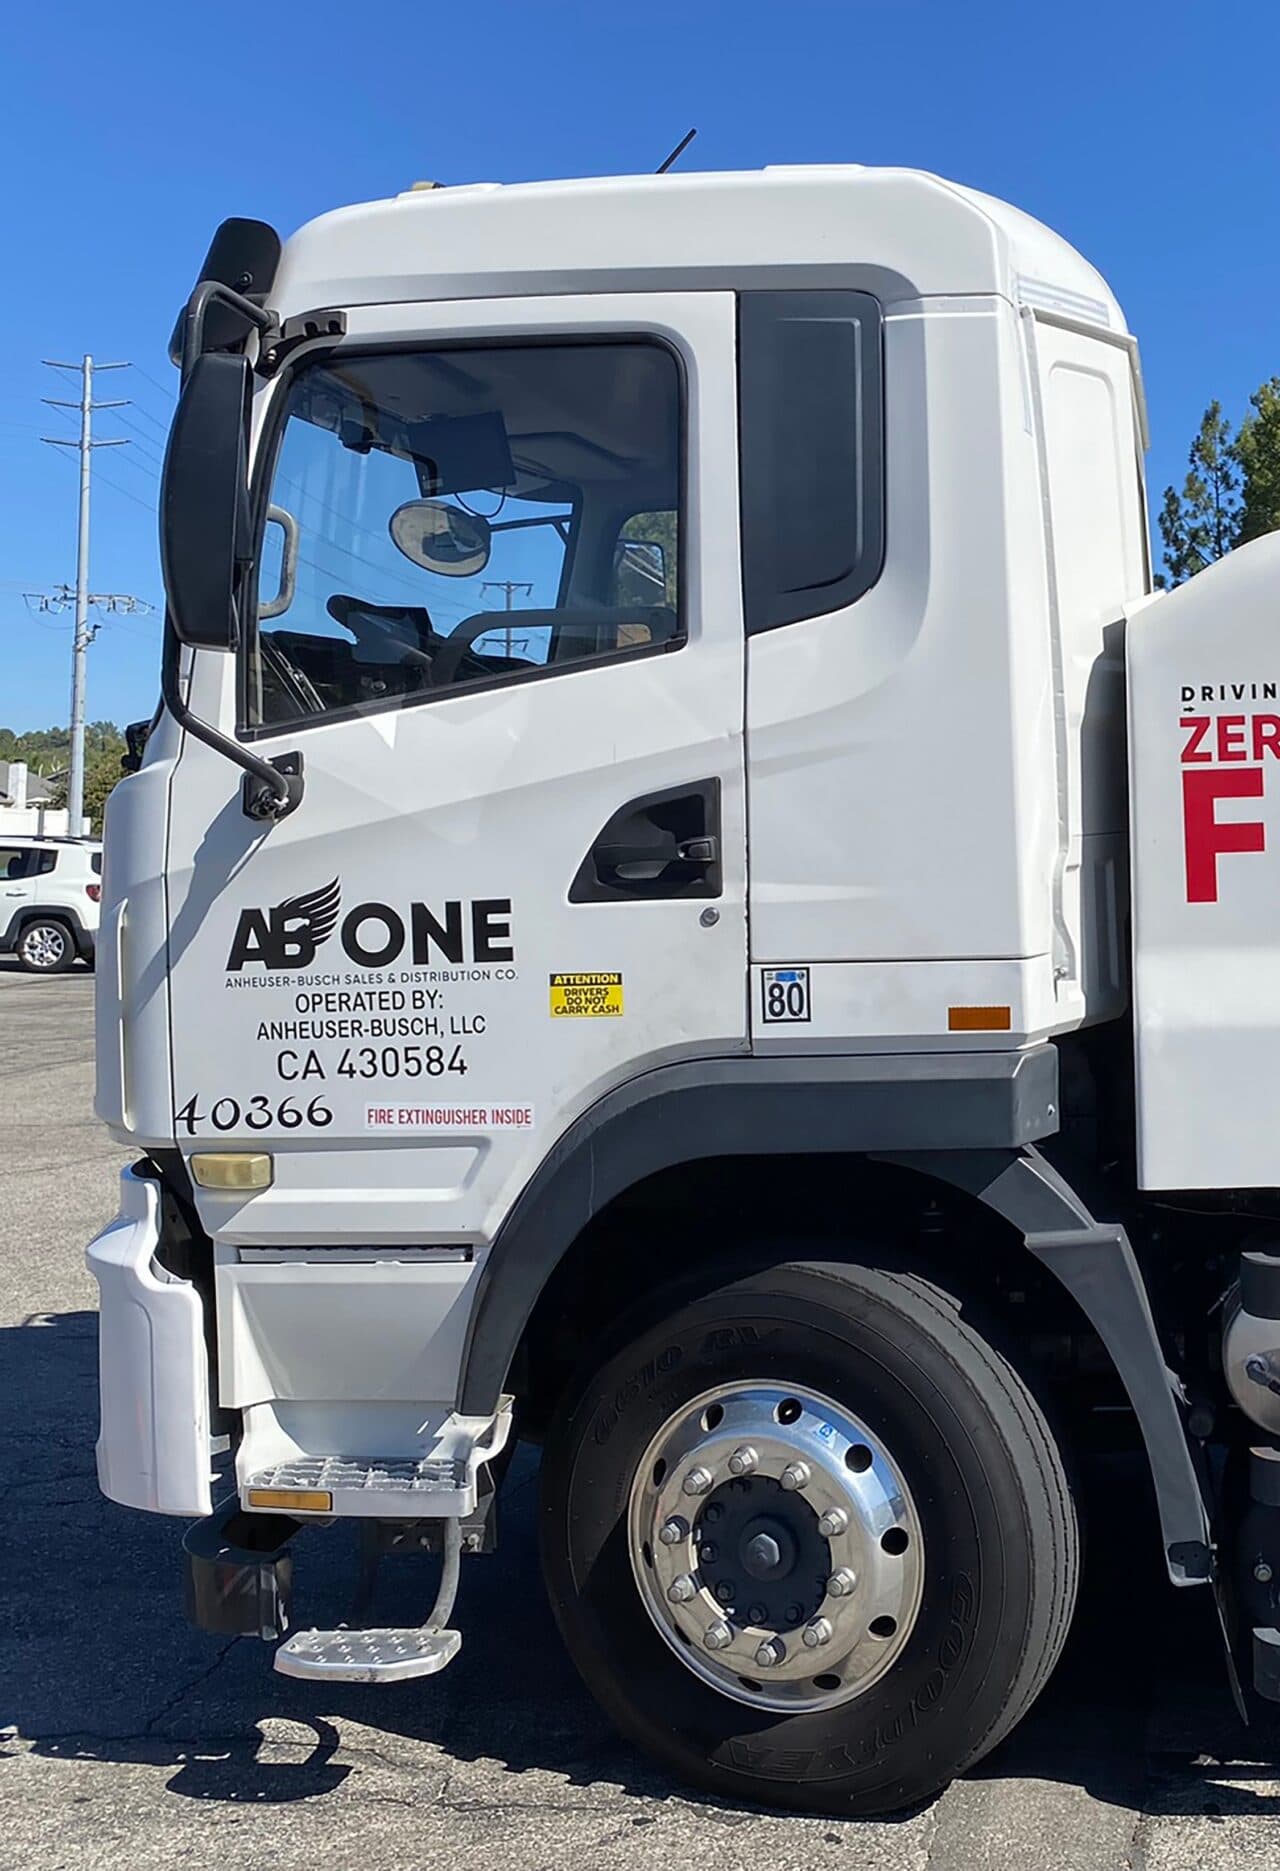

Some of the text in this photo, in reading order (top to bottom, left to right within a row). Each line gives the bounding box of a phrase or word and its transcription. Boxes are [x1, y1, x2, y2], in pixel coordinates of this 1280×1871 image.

[341, 898, 514, 968] ONE
[225, 968, 519, 988] ANHEUSER-BUSCH SALES & DISTRIBUTION CO.
[554, 974, 618, 984] ATTENTION
[295, 989, 444, 1013] OPERATED BY:
[563, 988, 609, 997] DRIVERS
[566, 996, 606, 1005] DO NOT
[768, 982, 805, 1018] 80
[554, 1004, 619, 1014] CARRY CASH
[257, 1015, 486, 1040] ANHEUSER-BUSCH, LLC
[277, 1045, 468, 1081] CA 430584
[175, 1093, 333, 1136] 40366
[368, 1108, 531, 1125] FIRE EXTINGUISHER INSIDE
